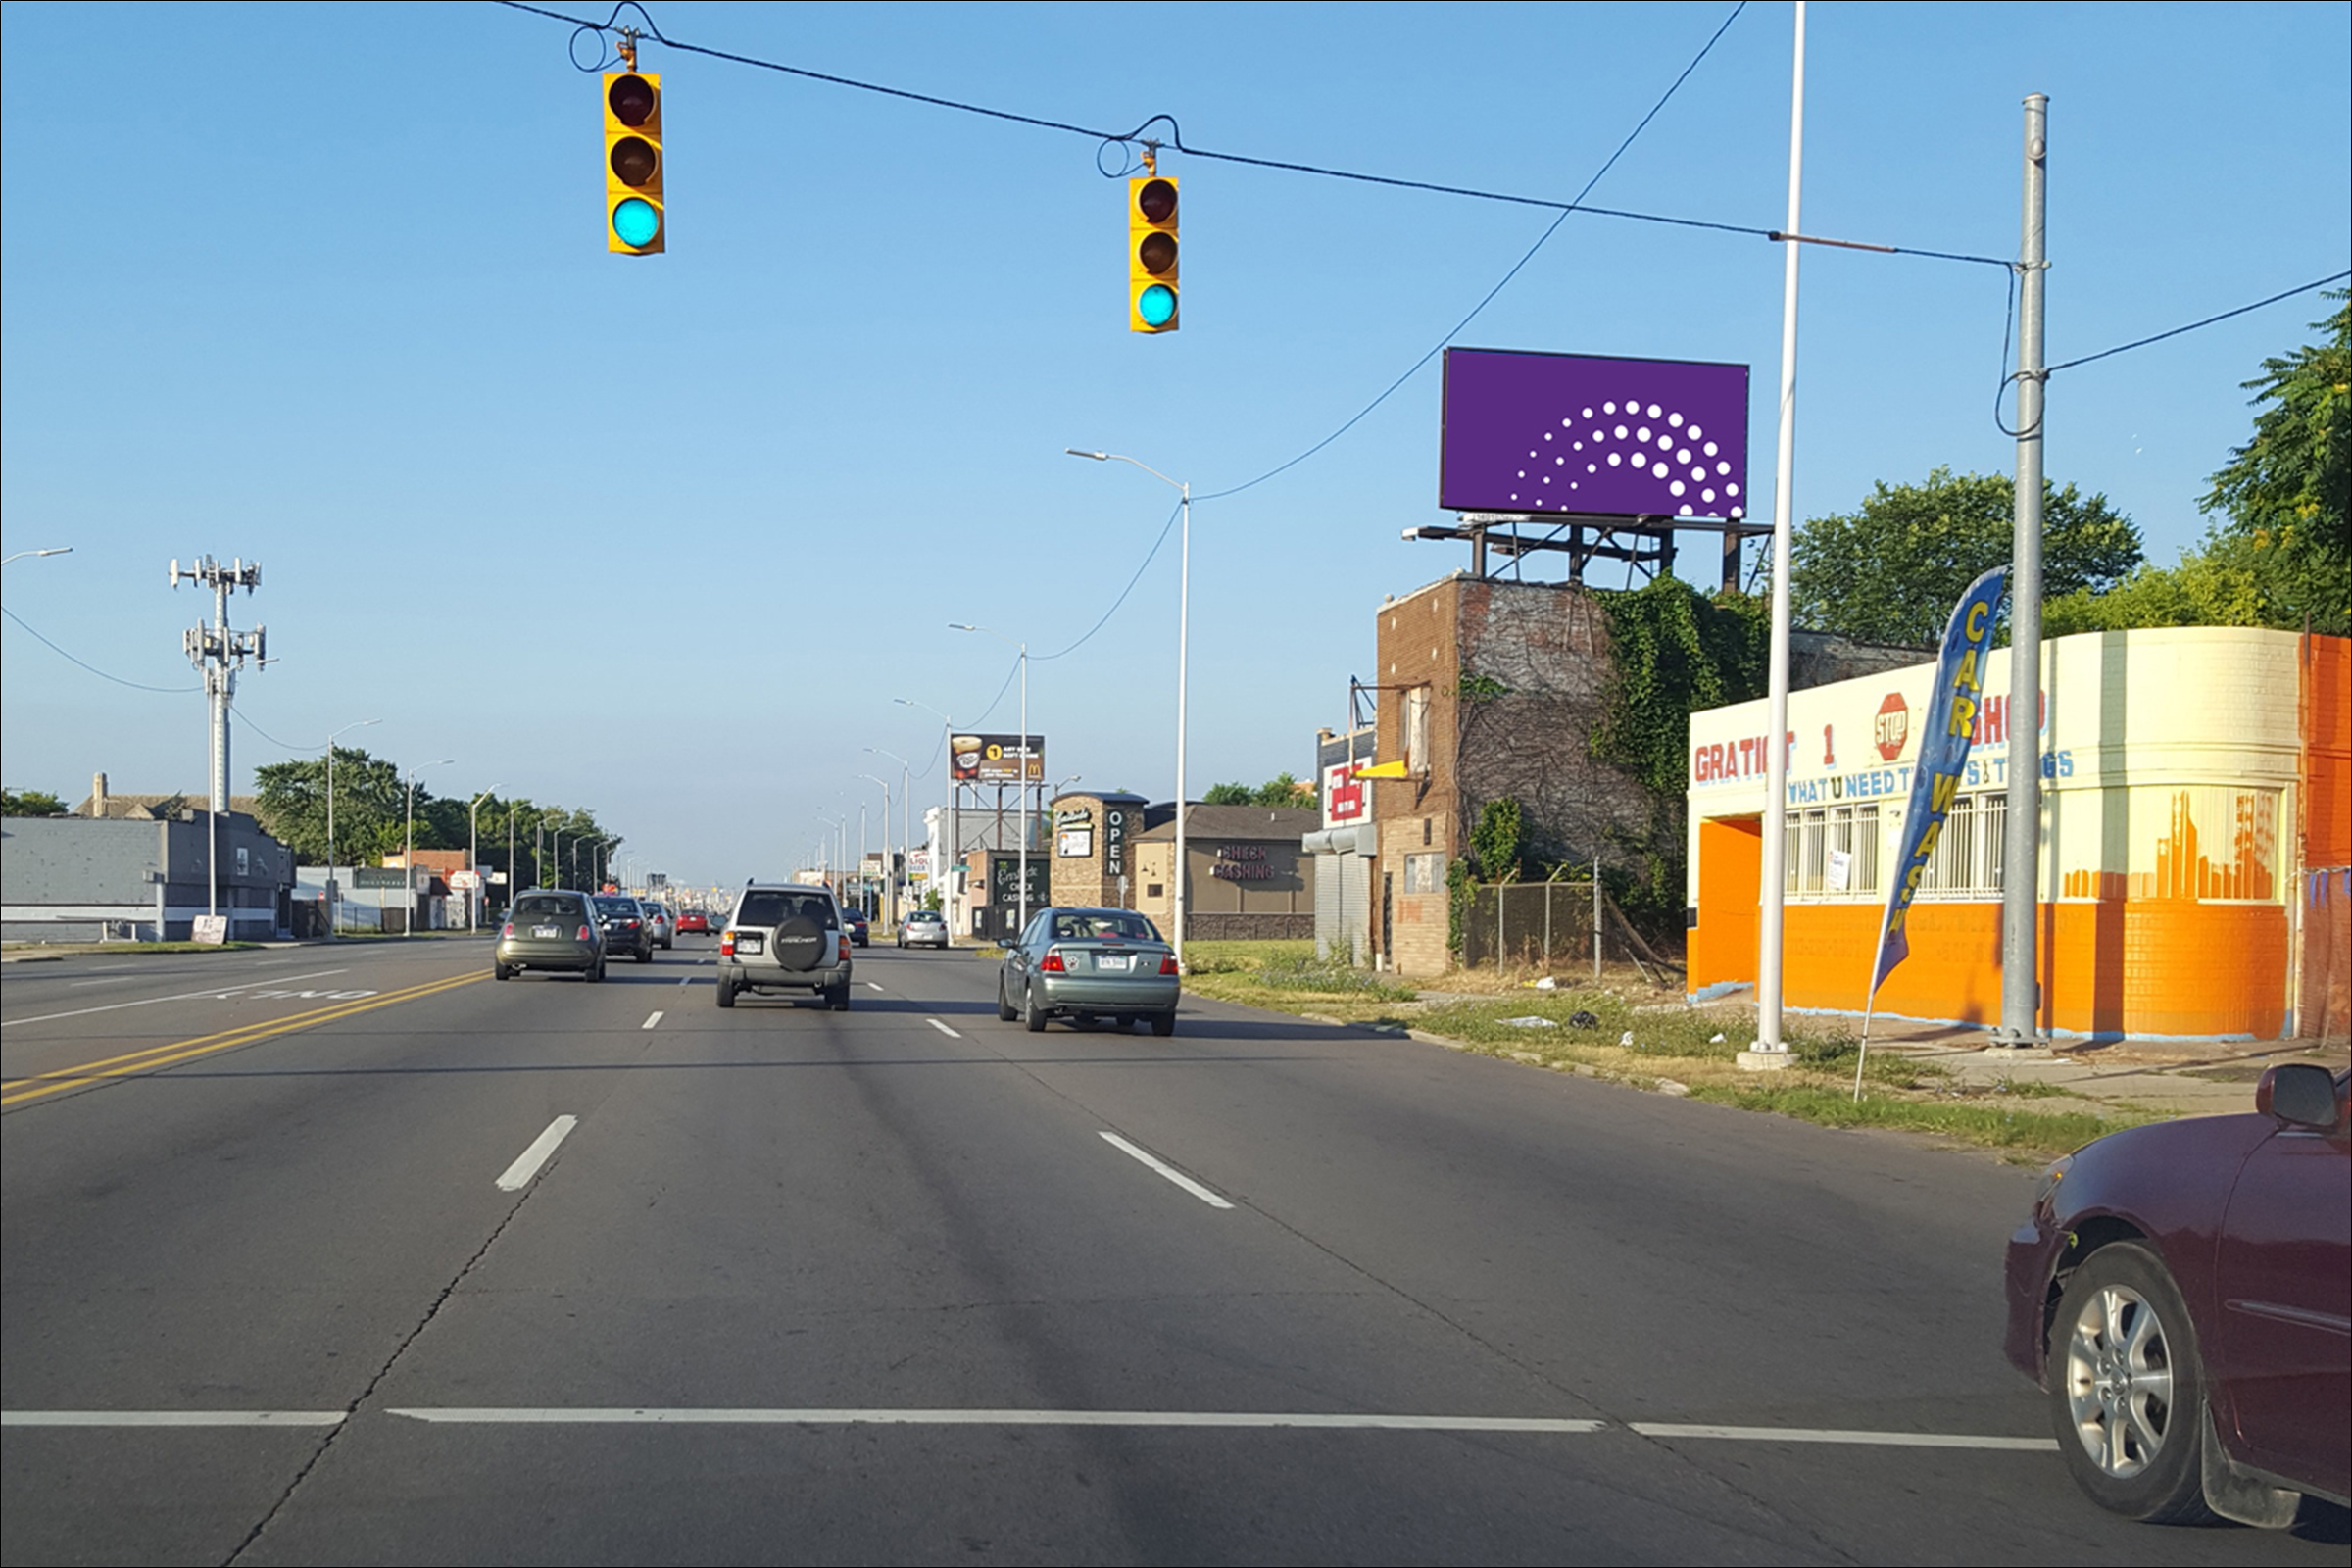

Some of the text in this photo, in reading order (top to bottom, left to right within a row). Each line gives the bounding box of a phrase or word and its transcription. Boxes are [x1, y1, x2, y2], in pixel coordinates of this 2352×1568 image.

[1947, 600, 1989, 739] CAR
[1695, 731, 1795, 783] GRATIT
[1876, 710, 1908, 743] STOP
[1787, 778, 1828, 804] WHAT
[1830, 776, 1843, 799] U
[1845, 768, 1895, 798] NEED
[1108, 811, 1123, 875] OPEN
[1221, 845, 1267, 860] CHECK
[1214, 862, 1275, 880] CASHING
